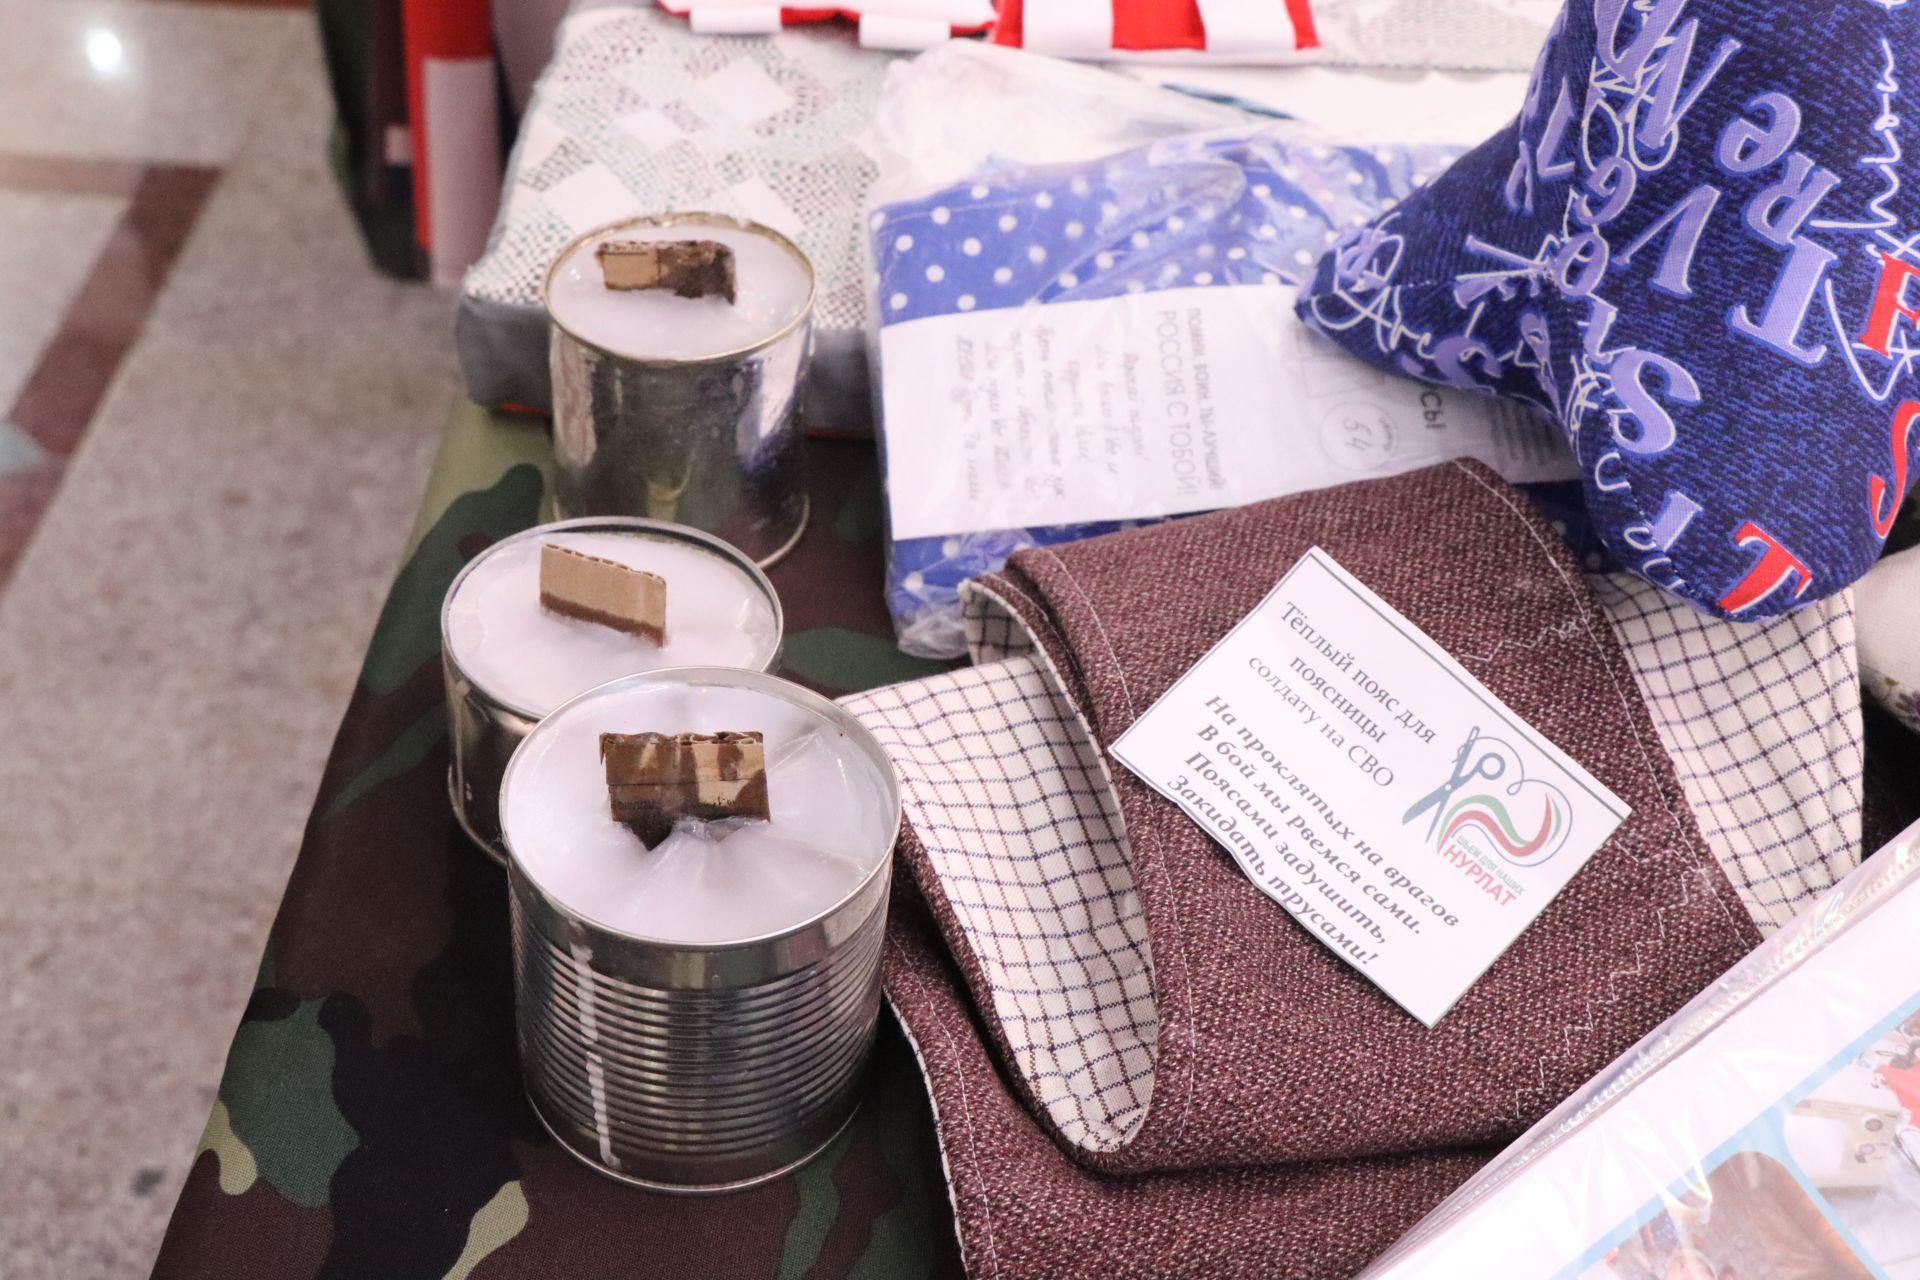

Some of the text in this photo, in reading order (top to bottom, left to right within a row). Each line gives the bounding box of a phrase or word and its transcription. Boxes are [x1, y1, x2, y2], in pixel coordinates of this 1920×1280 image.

[1156, 309, 1200, 496] РОССИЯ С ТОБОЙ!
[1420, 385, 1446, 429] СЫ
[1248, 656, 1395, 788] солдату на СВО
[1279, 601, 1437, 745] Тёплый пояс для
[1289, 656, 1388, 744] поясницы
[1167, 774, 1379, 966] Закидать трусами!
[1184, 751, 1386, 945] Поясами задушить,
[1196, 724, 1421, 935] В бой мы рвемся сами.
[1203, 695, 1460, 928] На проклятых на врагов
[1442, 844, 1517, 906] НУРЛАТ
